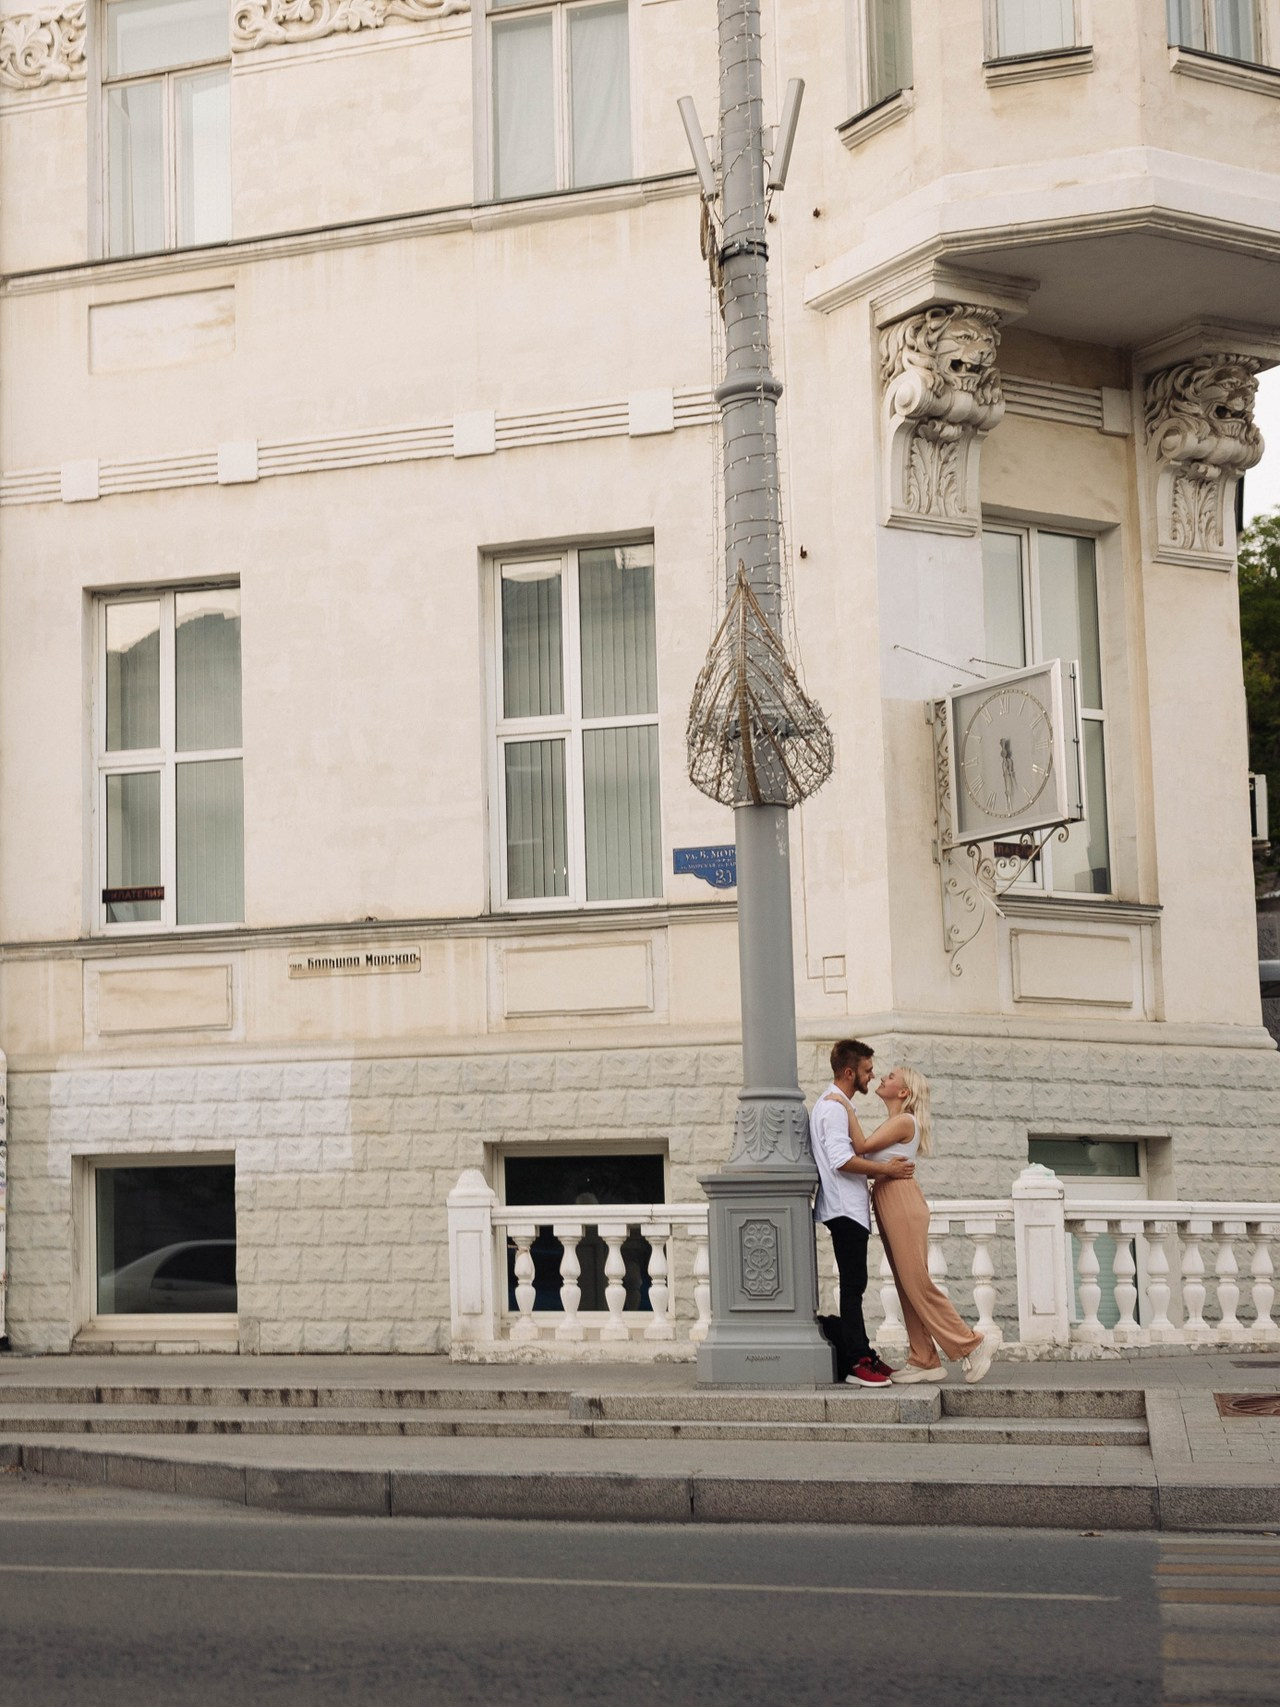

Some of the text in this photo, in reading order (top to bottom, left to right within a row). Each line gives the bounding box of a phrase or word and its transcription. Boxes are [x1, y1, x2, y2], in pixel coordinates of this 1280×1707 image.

[715, 869, 732, 884] 21
[307, 956, 360, 971] Большая
[365, 953, 417, 968] Морская
